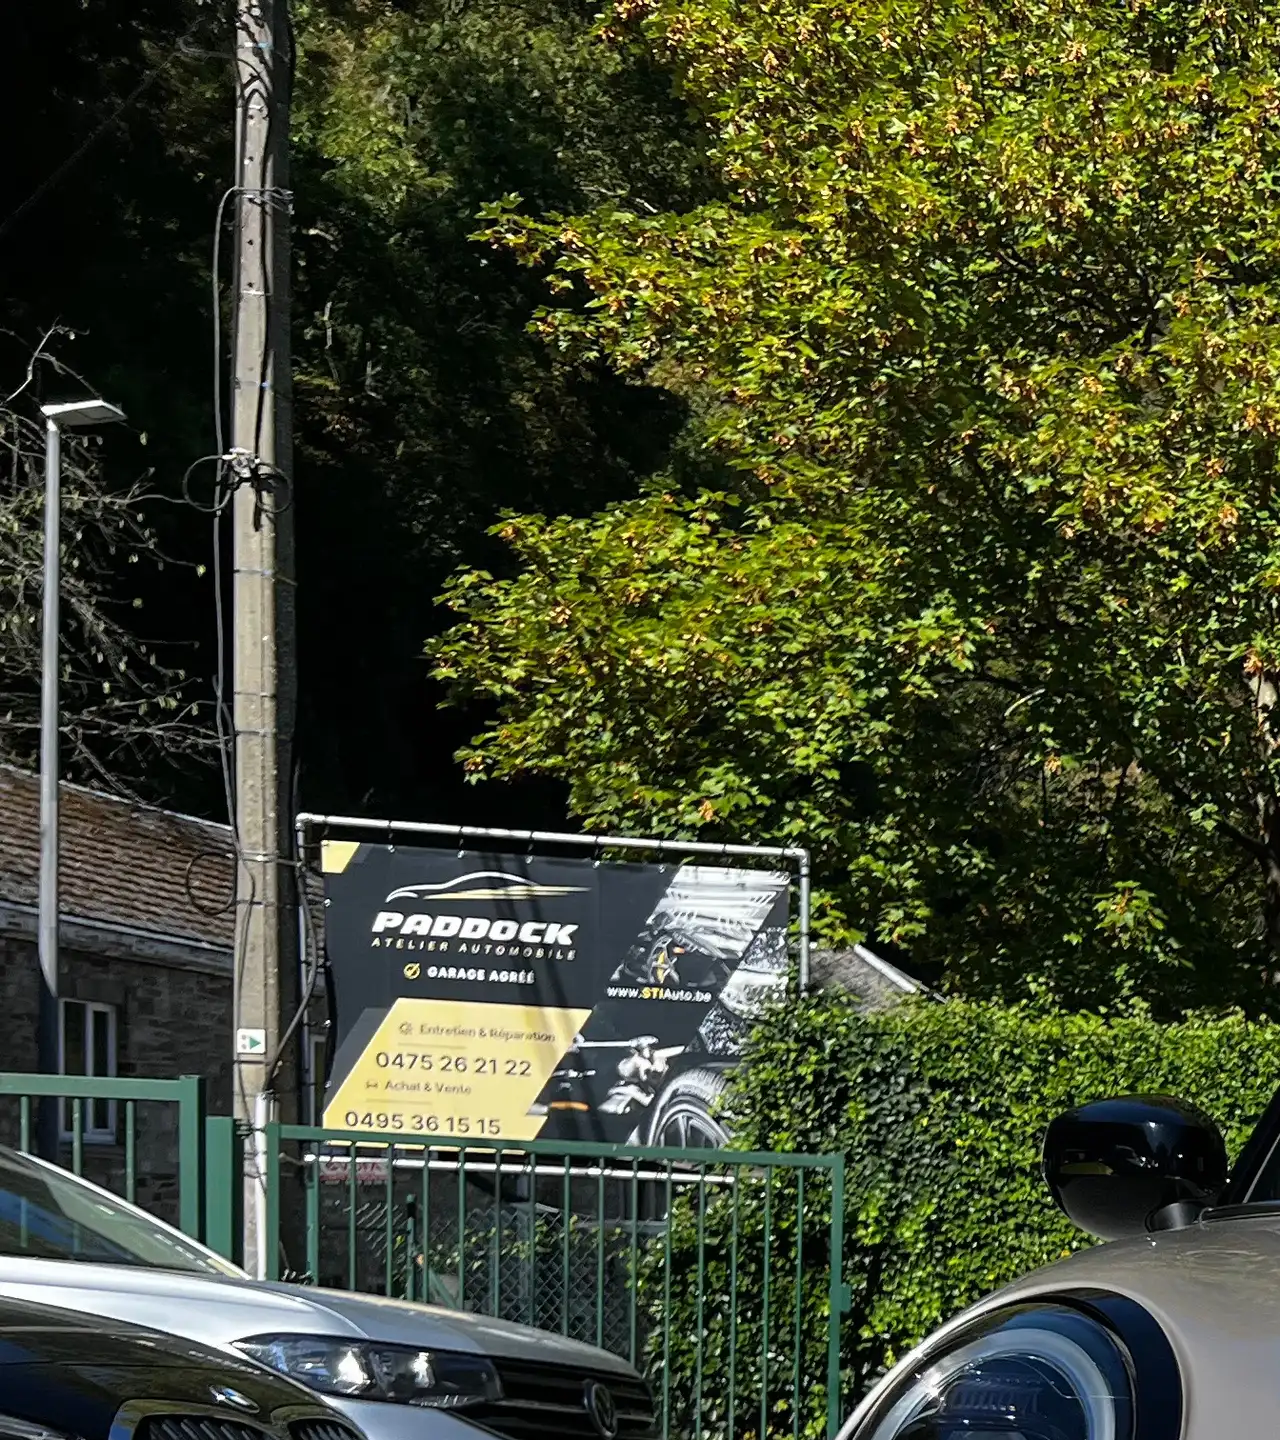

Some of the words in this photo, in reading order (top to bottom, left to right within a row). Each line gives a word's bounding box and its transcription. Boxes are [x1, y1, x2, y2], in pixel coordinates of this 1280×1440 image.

[371, 911, 579, 945] PADDOCK
[371, 937, 449, 952] ATELIER
[458, 942, 577, 961] AUTOMOBILE
[427, 965, 486, 982] GARAGE
[606, 986, 712, 1002] www.STIAuto.be
[420, 1024, 477, 1038] Entretien
[478, 1027, 488, 1037] &
[375, 1051, 434, 1071] 0475
[439, 1055, 468, 1073] 26
[474, 1057, 498, 1075] 21
[504, 1059, 532, 1077] 22
[384, 1080, 421, 1092] Achat
[423, 1081, 433, 1092] &
[435, 1082, 472, 1094] Vente
[344, 1111, 404, 1130] 0495
[410, 1114, 440, 1132] 36
[446, 1116, 471, 1134] 15
[476, 1118, 501, 1136] 15
